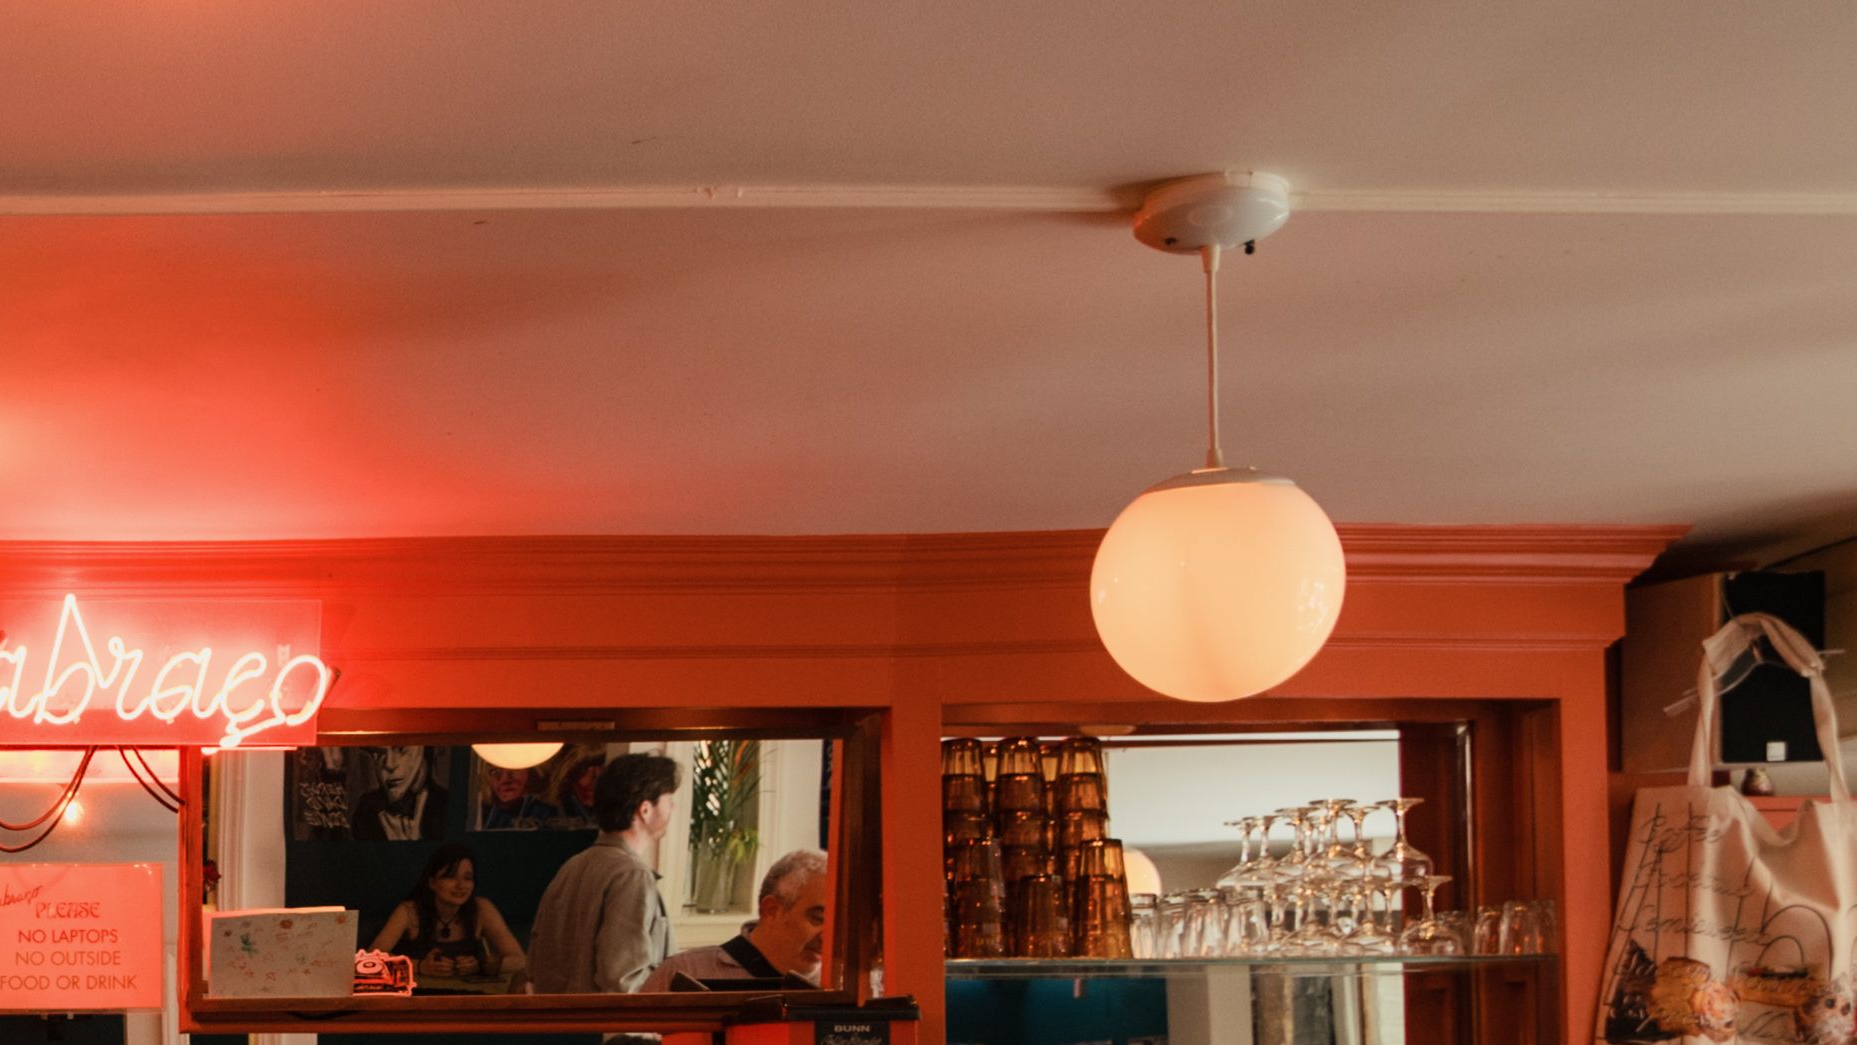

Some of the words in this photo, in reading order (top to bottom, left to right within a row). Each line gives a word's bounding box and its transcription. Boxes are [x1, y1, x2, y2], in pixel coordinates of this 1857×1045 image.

[35, 902, 101, 919] PLEASE
[18, 929, 47, 944] NO
[52, 929, 119, 944] LAPTOPS
[15, 951, 45, 966] NO
[50, 951, 121, 966] OUTSIDE
[0, 975, 51, 990] FOOD
[56, 975, 81, 990] OR
[86, 975, 138, 990] DRINK
[834, 1024, 871, 1033] BUNN
